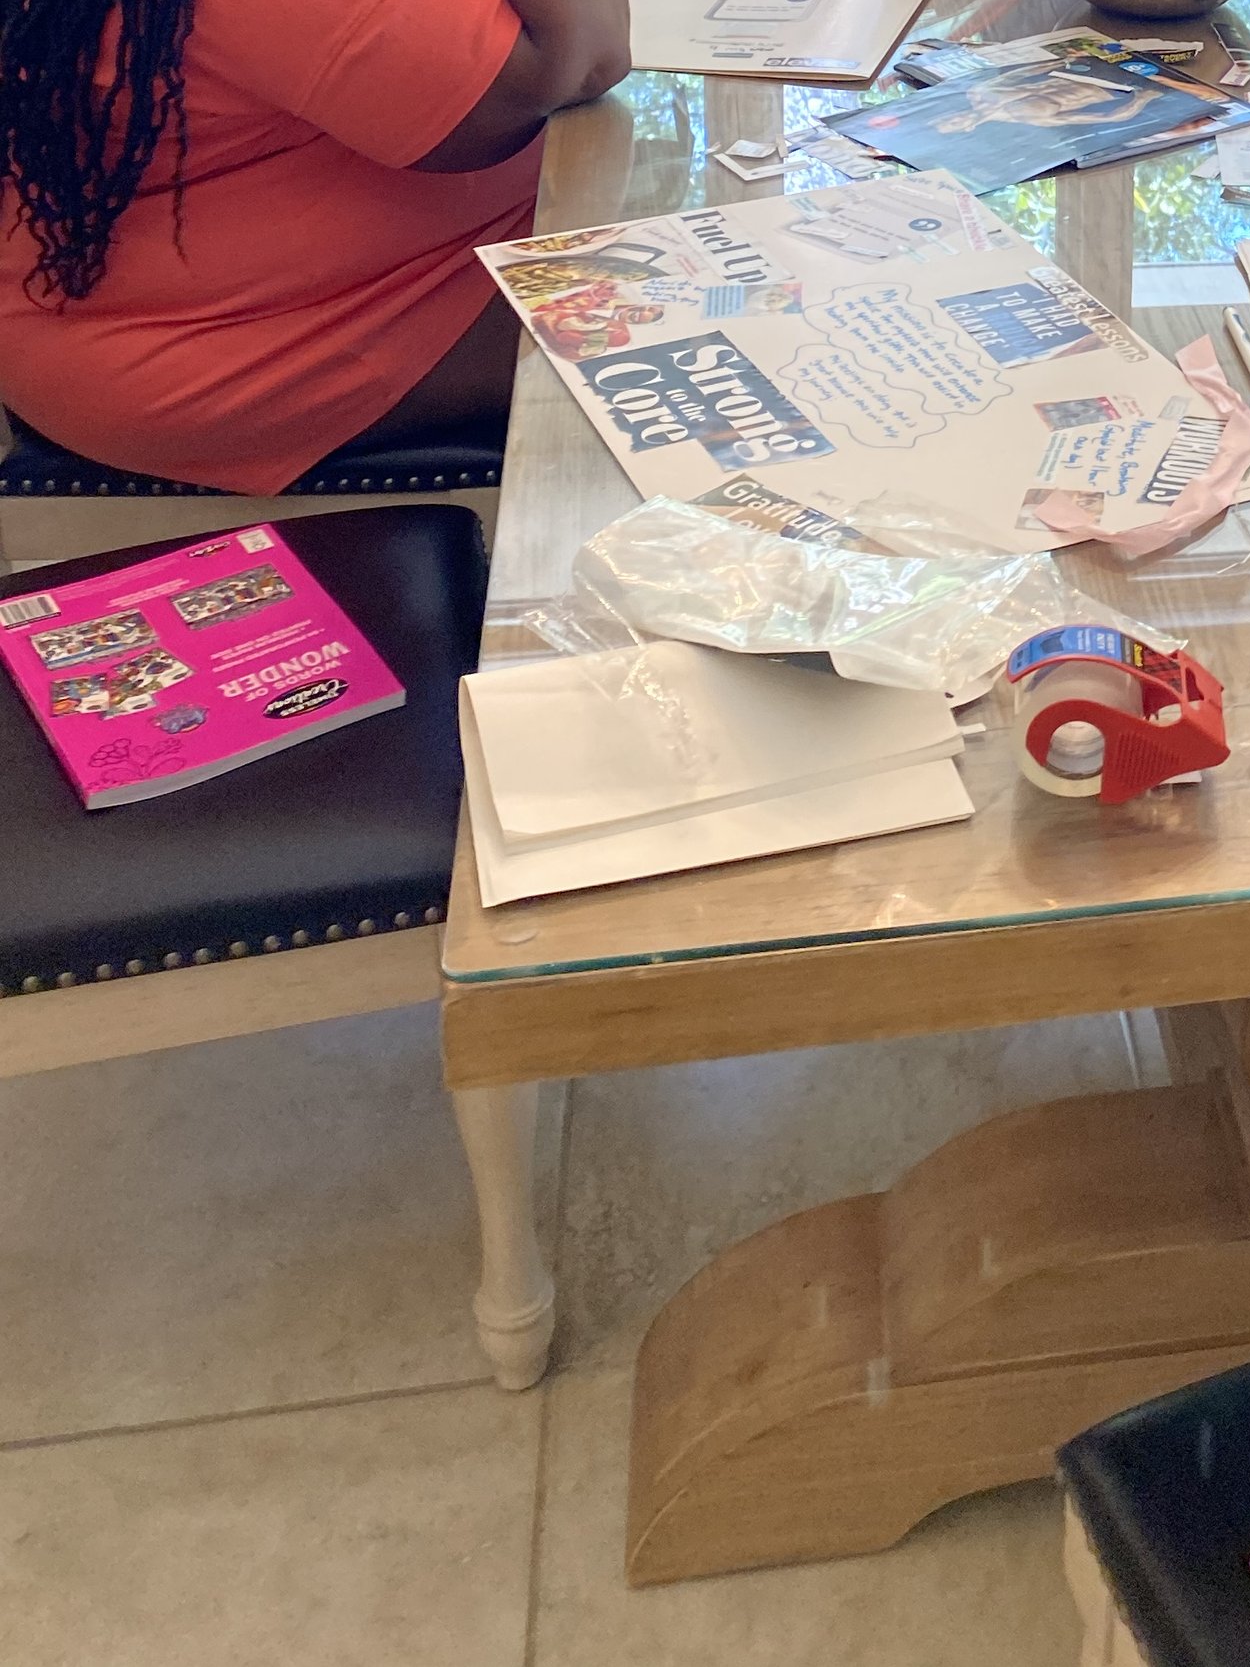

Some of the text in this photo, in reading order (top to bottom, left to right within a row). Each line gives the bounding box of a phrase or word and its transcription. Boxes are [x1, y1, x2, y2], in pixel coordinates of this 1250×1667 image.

[681, 210, 754, 255] Fuel
[722, 253, 773, 284] Up
[891, 305, 926, 331] mission
[974, 302, 1000, 313] A
[996, 291, 1063, 340] TO MAKE
[1029, 265, 1149, 364] Greatest Lessons
[1042, 304, 1081, 328] HAD
[904, 352, 921, 368] This
[919, 346, 937, 363] that
[932, 361, 951, 377] will
[594, 362, 689, 444] Core
[666, 388, 707, 423] to the
[668, 344, 816, 462] Strong
[723, 480, 843, 542] Gratitude
[218, 641, 353, 699] WONDER
[244, 660, 342, 704] WORDS OF
